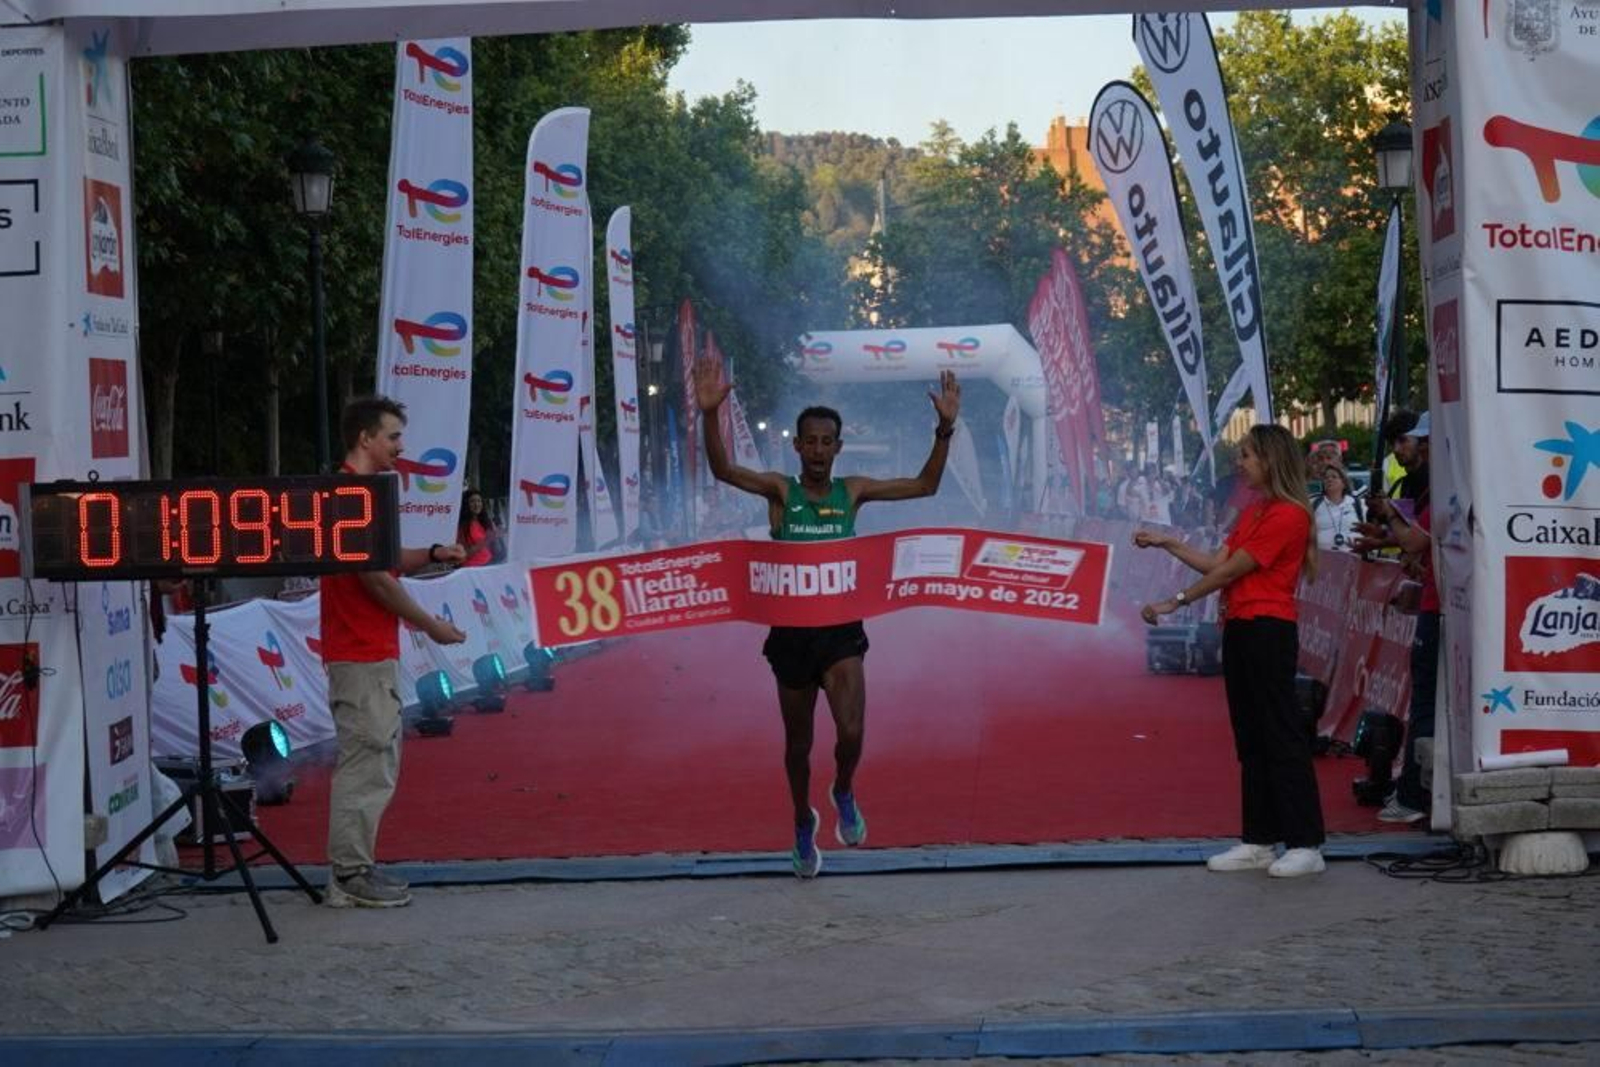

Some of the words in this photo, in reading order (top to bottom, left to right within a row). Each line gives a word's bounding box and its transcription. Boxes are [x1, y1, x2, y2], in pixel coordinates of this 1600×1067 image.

[1579, 25, 1597, 35] DE
[621, 570, 698, 600] Media
[749, 560, 857, 597] GANADOR
[555, 566, 620, 637] 38
[621, 582, 729, 616] Maratón
[885, 583, 895, 600] 7
[898, 580, 919, 597] de
[924, 582, 984, 601] mayo
[989, 583, 1018, 602] de
[1023, 588, 1080, 611] 2022
[1529, 604, 1600, 637] Lanja
